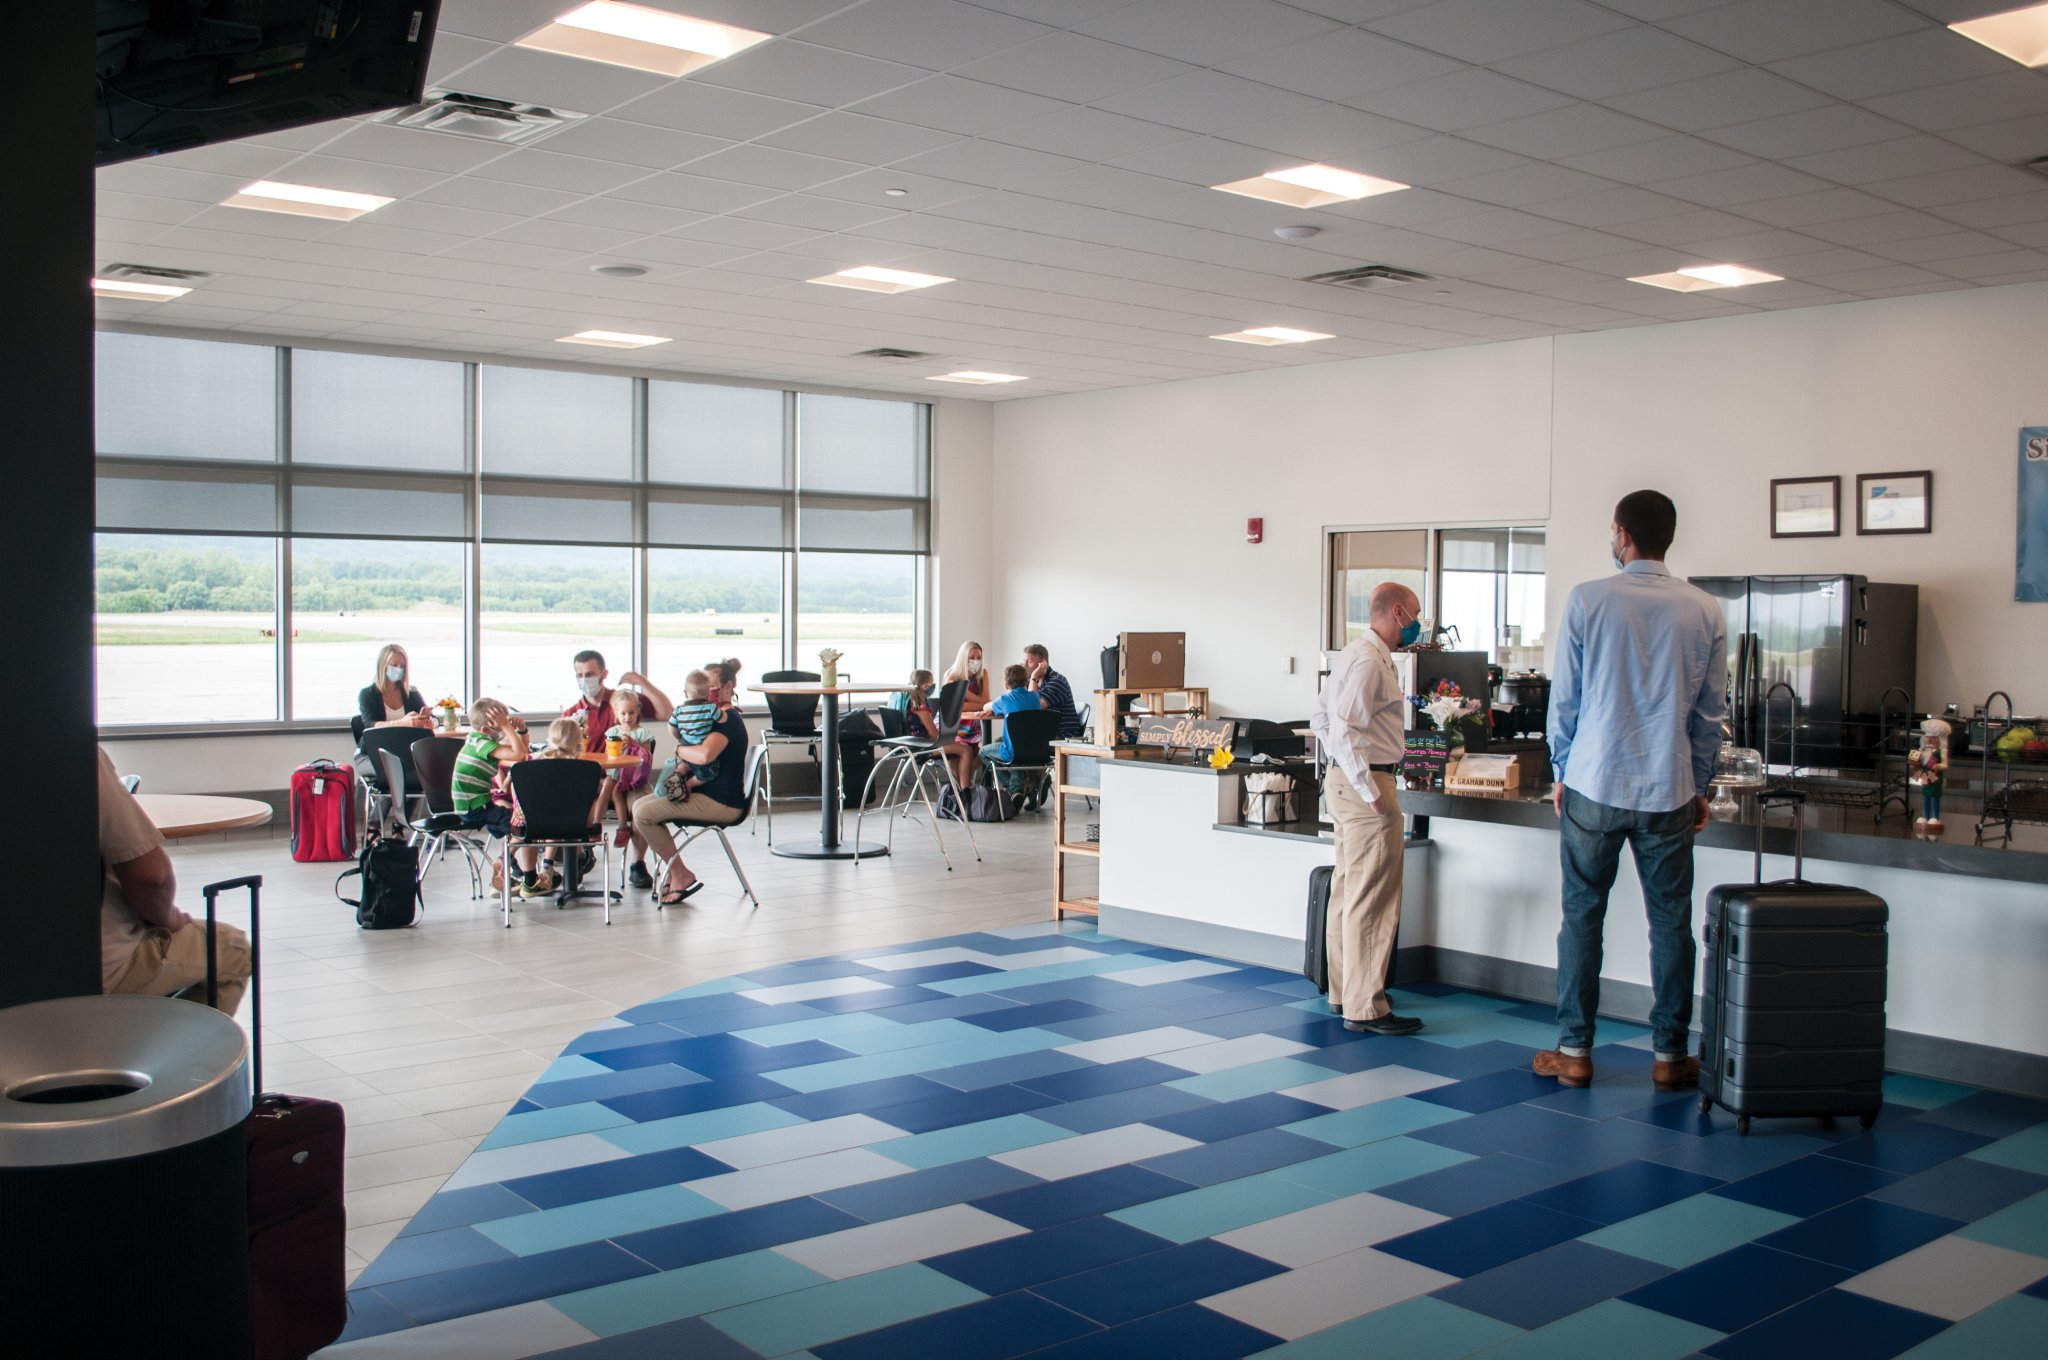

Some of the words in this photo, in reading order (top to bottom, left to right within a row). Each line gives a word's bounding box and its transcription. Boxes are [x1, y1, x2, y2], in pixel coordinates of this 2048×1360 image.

[1140, 731, 1172, 743] SIMPLY
[1169, 720, 1232, 748] blessed
[1457, 778, 1485, 786] GRAHAM
[1486, 779, 1505, 787] DUNN
